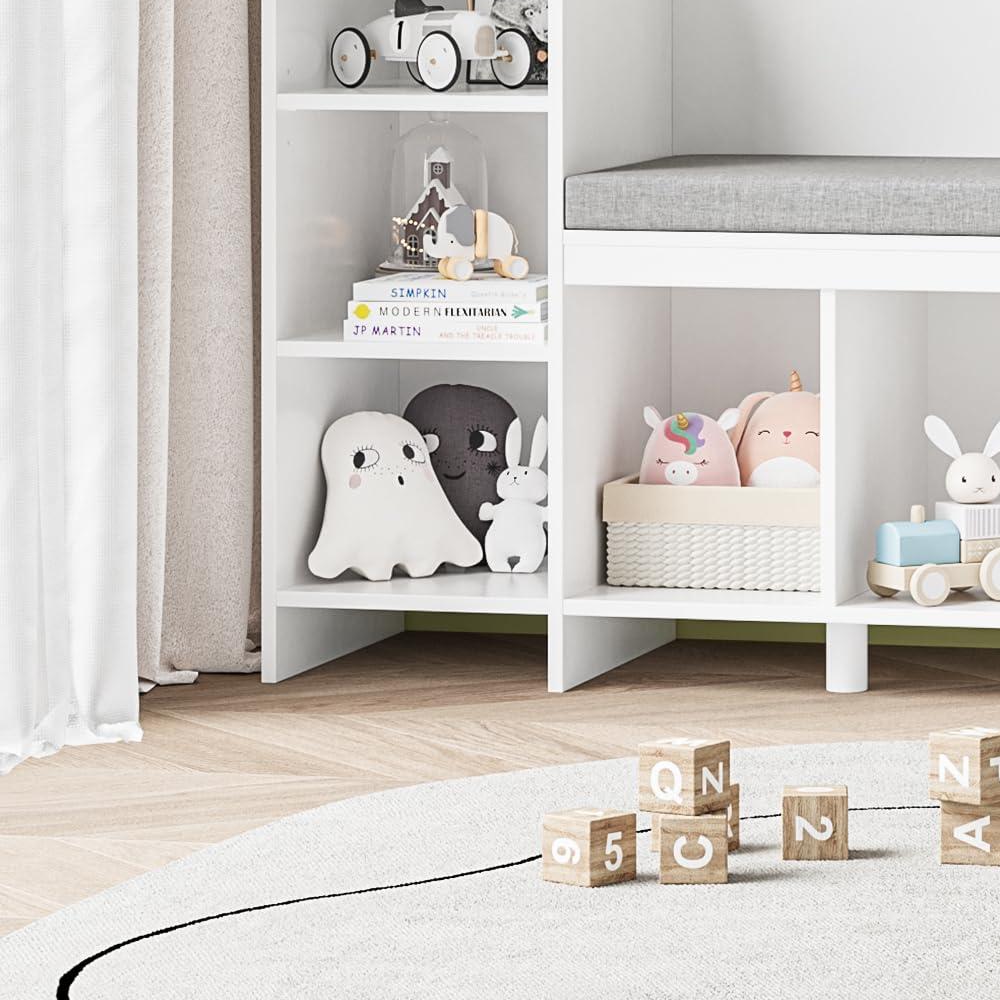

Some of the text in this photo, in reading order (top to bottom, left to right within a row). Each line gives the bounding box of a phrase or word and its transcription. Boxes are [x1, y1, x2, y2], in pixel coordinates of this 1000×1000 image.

[397, 20, 404, 49] 1
[391, 288, 447, 299] SIMPKIN
[379, 306, 507, 317] MODERN FLEXITARIAN
[353, 325, 421, 336] JP MARTIN
[650, 760, 684, 805] Q
[953, 815, 991, 853] A
[605, 831, 623, 872] 5
